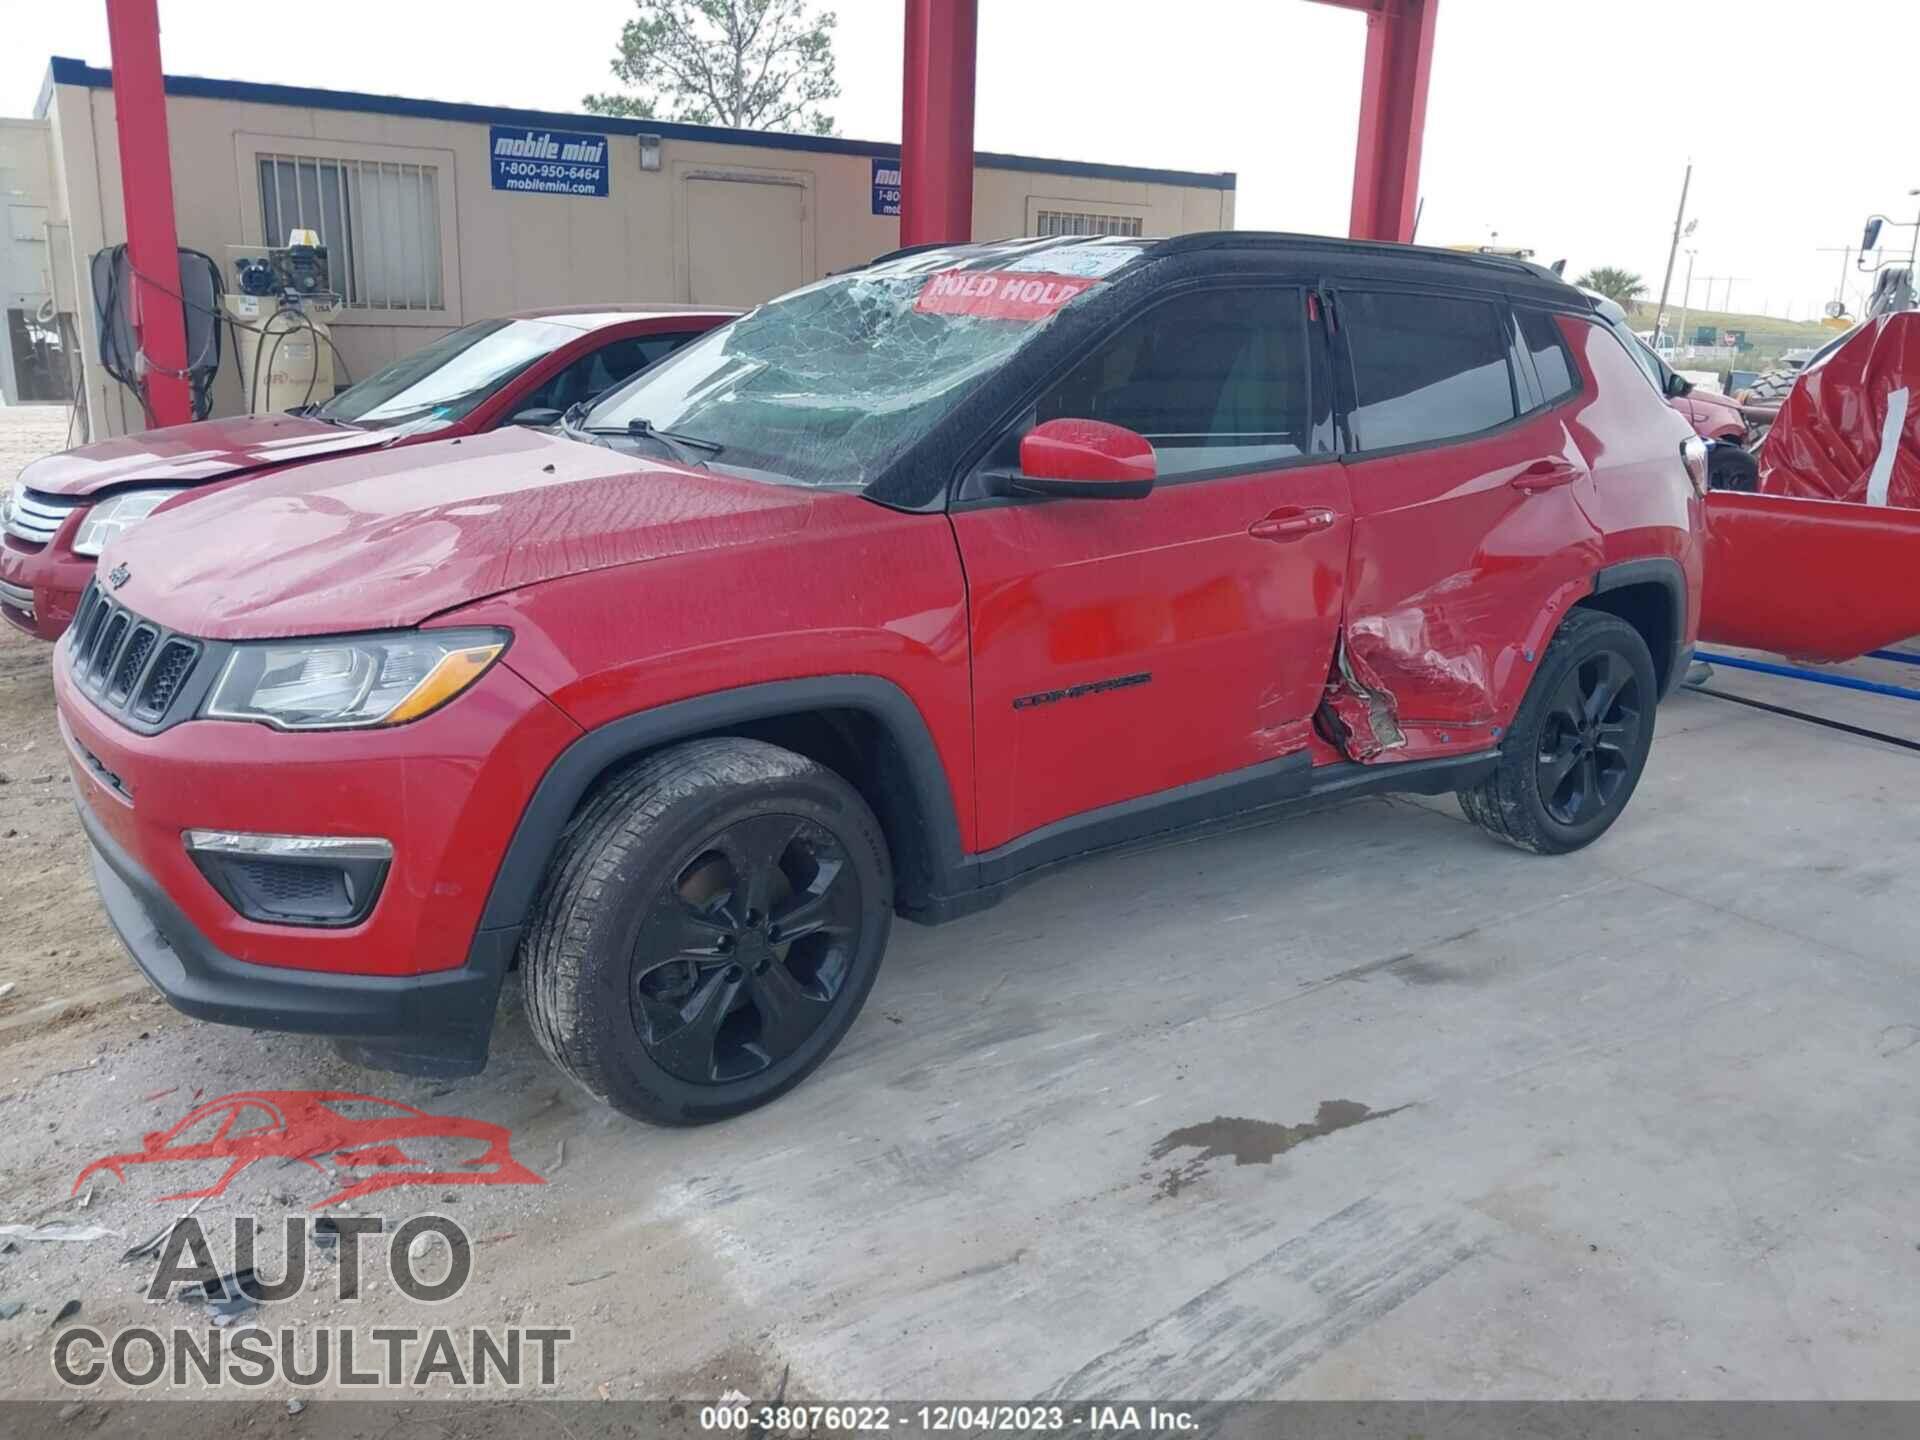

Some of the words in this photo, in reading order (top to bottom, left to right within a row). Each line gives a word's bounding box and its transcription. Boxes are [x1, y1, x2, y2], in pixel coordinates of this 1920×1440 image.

[494, 132, 559, 159] mobile
[561, 141, 605, 163] mini
[500, 162, 600, 181] 1-800-950-6464
[506, 178, 596, 194] mobilemini.com
[929, 275, 999, 298] HOLD
